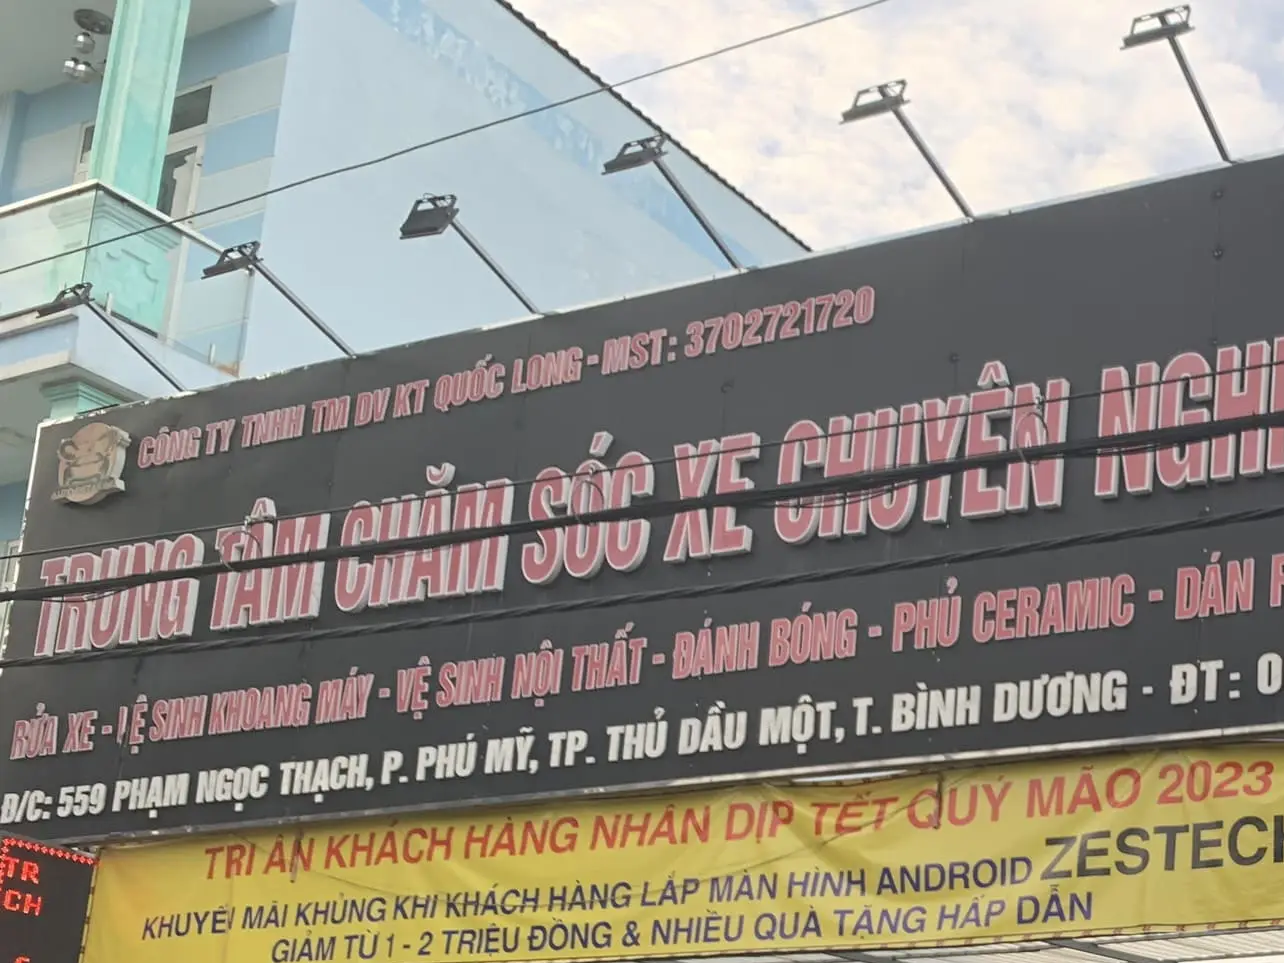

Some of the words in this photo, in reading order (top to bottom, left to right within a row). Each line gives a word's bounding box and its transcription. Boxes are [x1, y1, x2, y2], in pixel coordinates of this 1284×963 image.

[137, 426, 201, 469] CÔNG
[205, 419, 235, 455] TY
[241, 405, 305, 448] TNHH
[311, 396, 351, 434] TM
[353, 387, 391, 427] DV
[392, 379, 430, 418] KT
[433, 354, 506, 411] QUỐC
[684, 285, 875, 358] 3702721720
[34, 533, 204, 657] TRUNG
[210, 496, 332, 630] TÂM
[334, 463, 515, 614] CHĂM
[521, 431, 655, 584] SÓC
[664, 431, 761, 563] XE
[774, 361, 1071, 544] CHUYÊN
[10, 703, 59, 760] RỬA
[62, 710, 98, 753] XE
[149, 694, 207, 743] SINH
[208, 680, 312, 737] KHOANG
[315, 666, 375, 724] MÁY
[397, 655, 431, 720] VỆ
[436, 655, 506, 709] SINH
[511, 639, 564, 707] NỘI
[571, 622, 647, 692] THẤT
[672, 618, 760, 680] ĐÁNH
[768, 601, 858, 667] BÓNG
[891, 575, 962, 653] PHỦ
[972, 572, 1135, 645] CERAMIC
[1174, 551, 1255, 620] DÁN
[56, 782, 108, 818] 559
[111, 772, 191, 819] PHẠM
[195, 763, 271, 812] NGỌC
[279, 752, 374, 803] THẠCH,
[381, 749, 408, 786] P.
[415, 732, 478, 782] PHÚ
[483, 725, 539, 775] MỸ,
[547, 728, 596, 769] TP.
[605, 706, 668, 763] THỦ
[677, 700, 749, 756] DẦU
[758, 693, 846, 755] MỘT,
[852, 696, 882, 738] T.
[890, 681, 982, 733] BÌNH
[992, 669, 1128, 723] DƯƠNG
[205, 843, 256, 881] TRI
[262, 833, 315, 876] ÂN
[324, 819, 455, 871] KHÁCH
[463, 814, 580, 862] HÀNG
[589, 803, 711, 851] NHÂN
[724, 799, 794, 844] DỊP
[810, 789, 899, 837] TẾT
[906, 774, 1014, 830] QUÝ
[1026, 764, 1142, 819] MÃO
[1156, 759, 1275, 806] 2023
[241, 901, 287, 930] MÃI
[295, 891, 387, 928] KHỦNG
[393, 893, 439, 922] KHI
[444, 882, 541, 919] KHÁCH
[548, 879, 631, 911] HÀNG
[641, 869, 700, 908] LẮP
[709, 868, 778, 903] MÀN
[786, 866, 866, 899] HÌNH
[876, 856, 1033, 896] ANDROID
[271, 928, 337, 963] GIẢM
[345, 929, 381, 959] TỪ
[386, 935, 394, 958] 1
[418, 932, 433, 956] 2
[442, 923, 520, 957] TRIỆU
[527, 915, 613, 951] ĐỒNG
[621, 922, 641, 947] &
[651, 908, 745, 944] NHIỀU
[753, 905, 823, 941] QUÀ
[833, 901, 926, 939] TẶNG
[936, 894, 1006, 929] HẤP
[1017, 883, 1093, 924] DẪN
